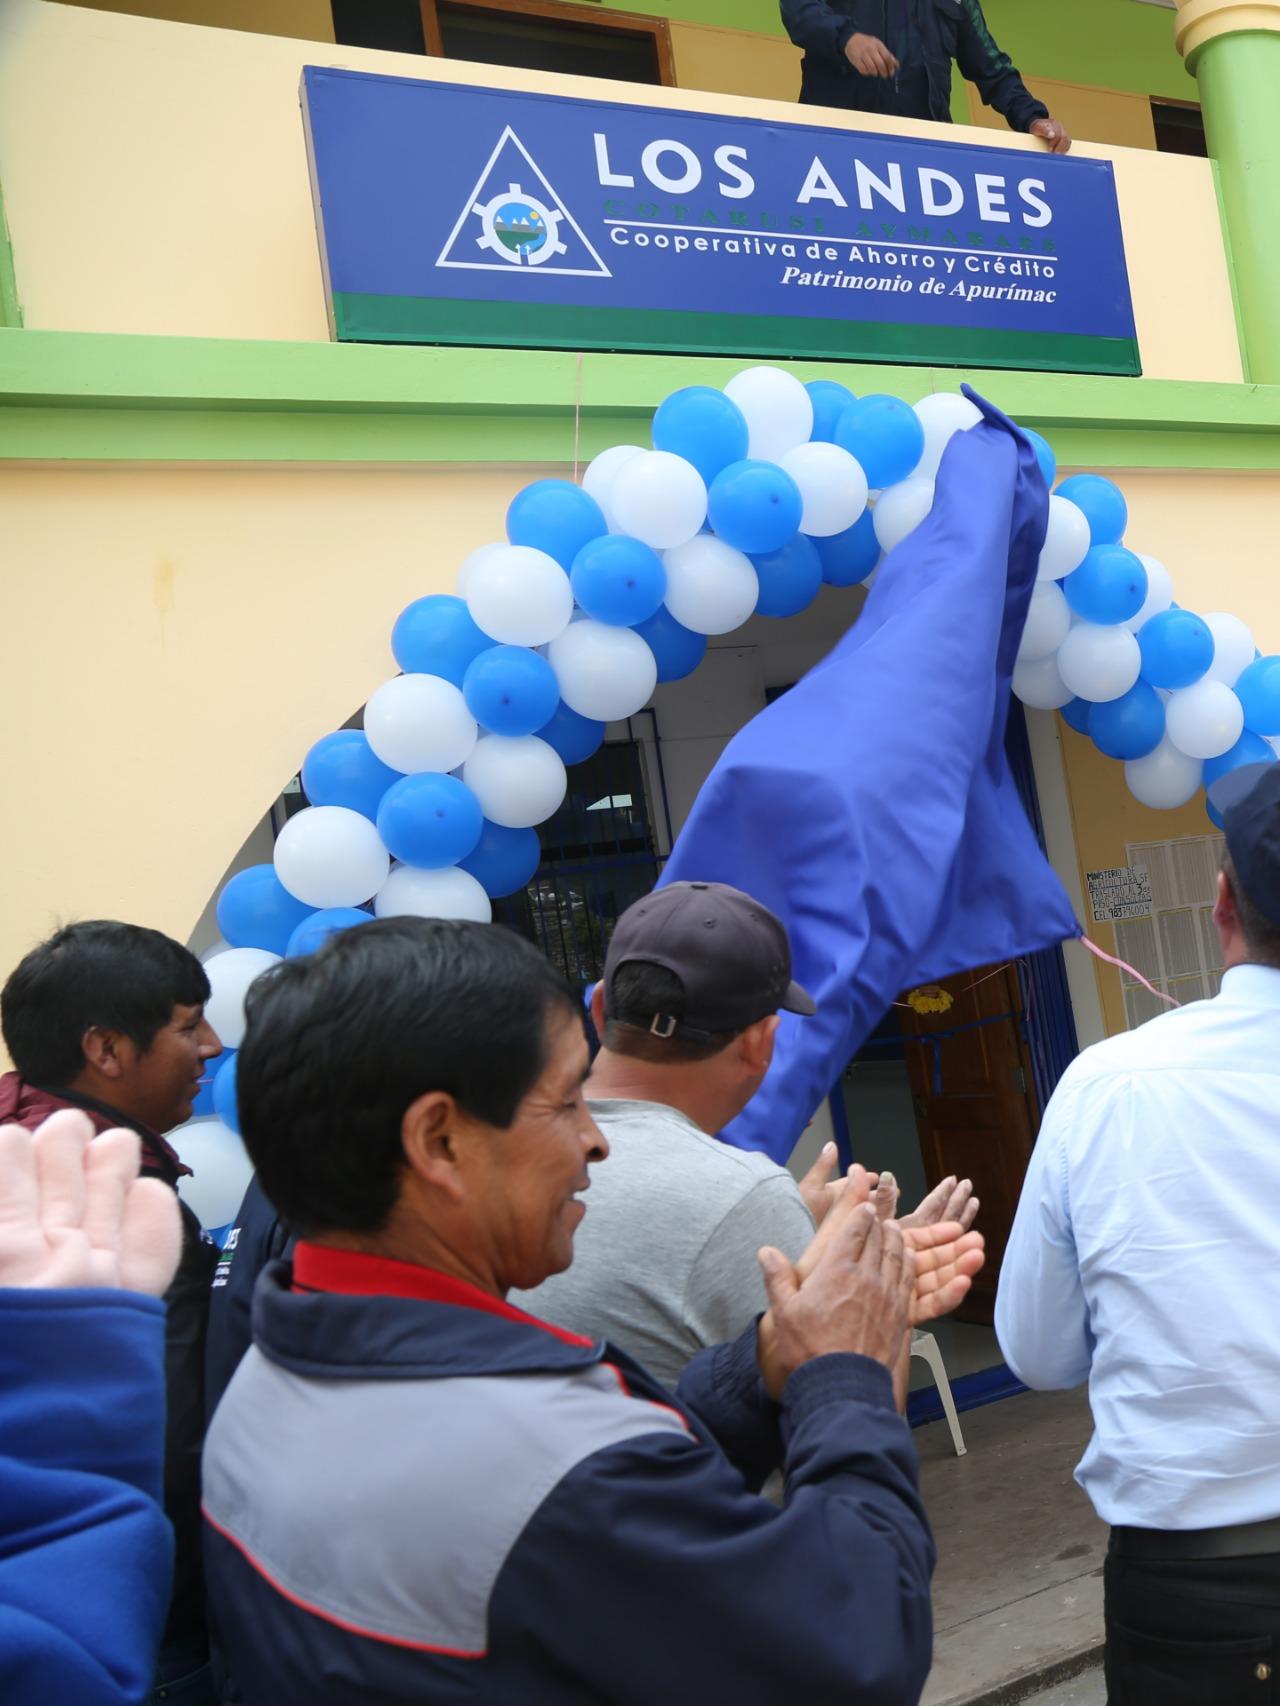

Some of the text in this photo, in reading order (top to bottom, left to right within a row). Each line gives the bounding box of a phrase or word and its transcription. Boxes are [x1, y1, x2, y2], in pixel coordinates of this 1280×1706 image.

[594, 133, 1053, 228] LOS ANDES
[603, 199, 1057, 251] COTARUSI AYMARAES
[610, 227, 1055, 278] Cooperativa de Ahorro y Crédito
[781, 266, 1057, 303] Patrimonio de Apurímac
